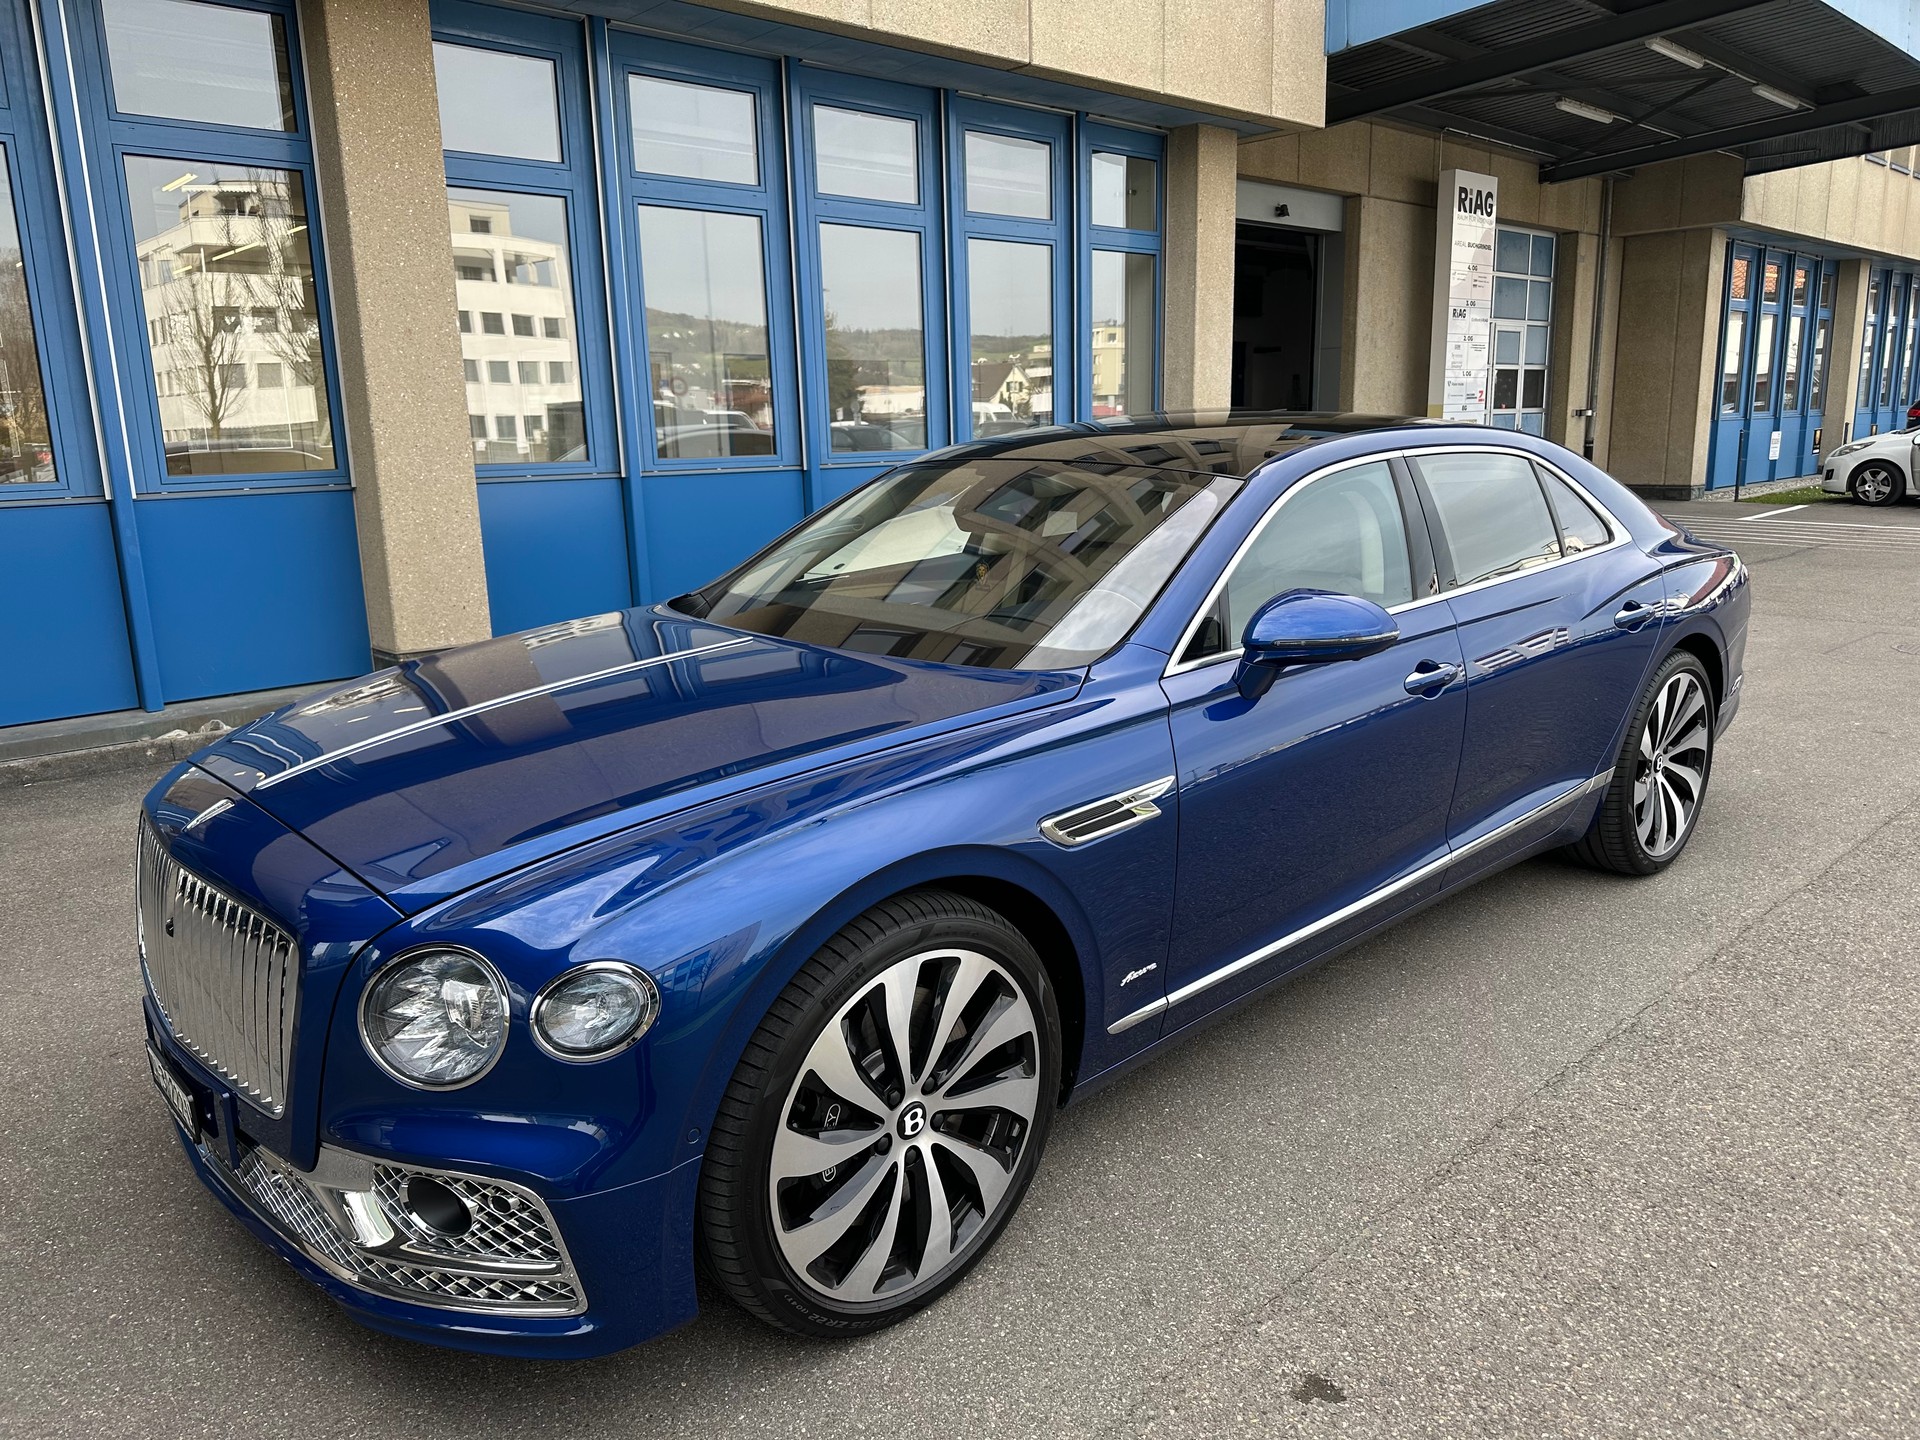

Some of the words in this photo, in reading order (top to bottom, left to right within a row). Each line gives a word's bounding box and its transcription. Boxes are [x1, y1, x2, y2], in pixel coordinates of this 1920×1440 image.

[1458, 186, 1494, 217] RiAG
[823, 962, 866, 1010] PIRELLI
[903, 1107, 925, 1136] B
